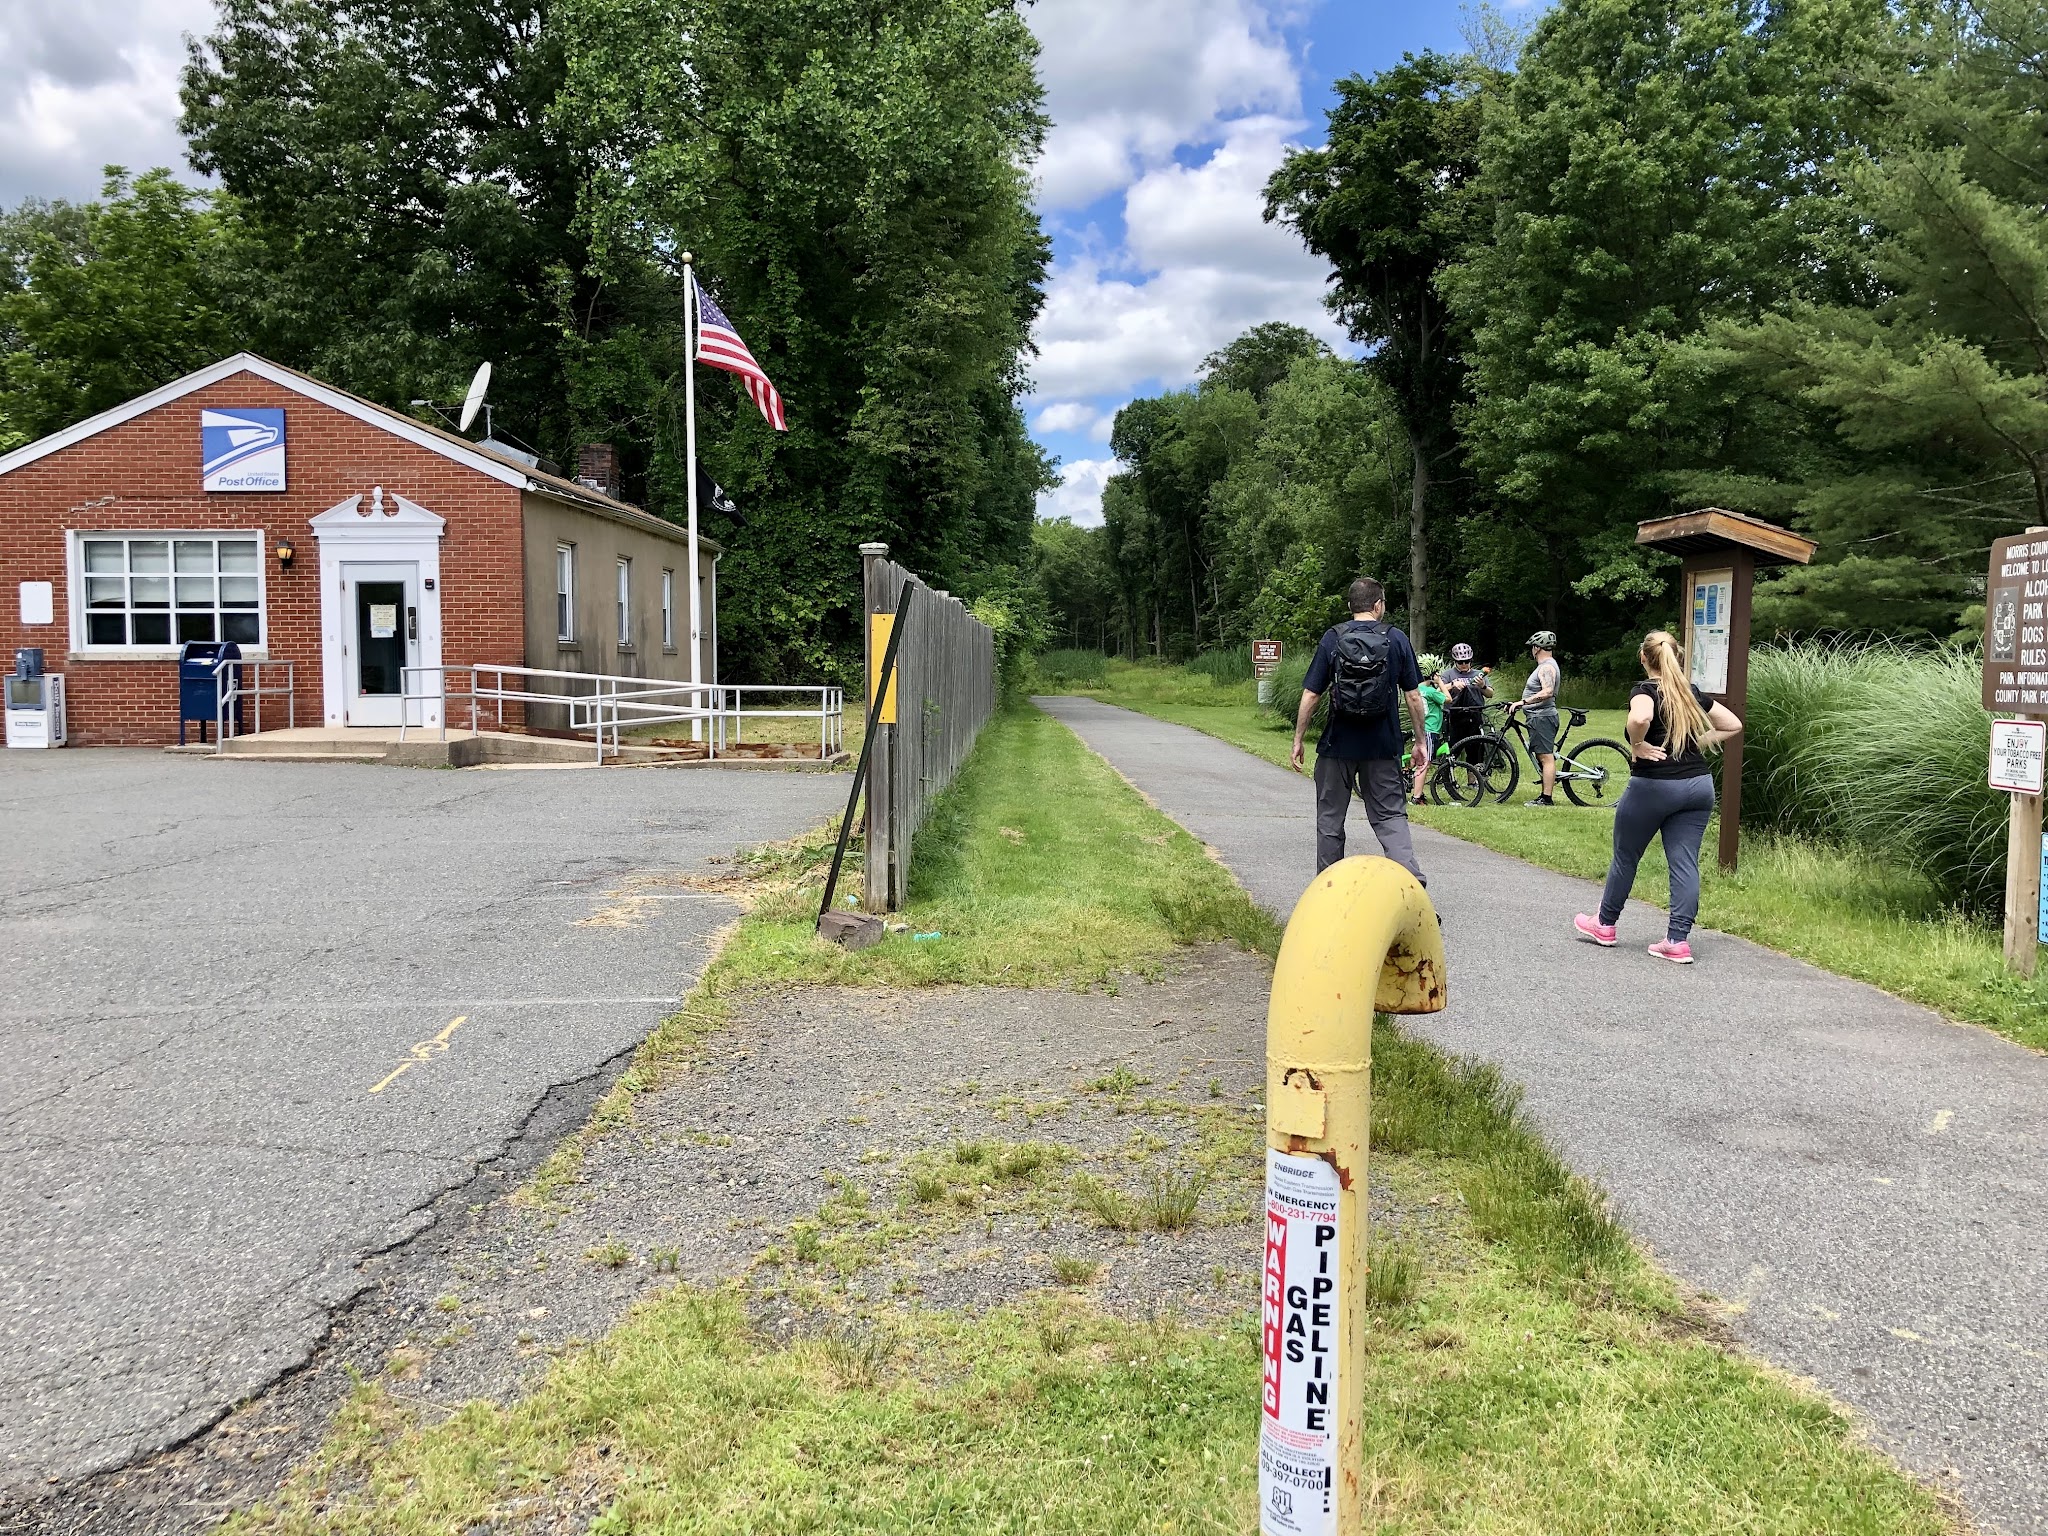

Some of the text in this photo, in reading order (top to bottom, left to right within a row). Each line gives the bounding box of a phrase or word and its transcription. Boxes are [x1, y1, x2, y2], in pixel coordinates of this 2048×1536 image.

[219, 476, 279, 486] Post Office
[2006, 543, 2029, 560] MORRIS
[2001, 561, 2030, 577] WELCOME
[2032, 560, 2040, 574] TO
[2023, 602, 2044, 620] PARK
[2022, 626, 2044, 644] DOGS
[2021, 648, 2046, 666] RULES
[2000, 671, 2015, 685] PARK
[1995, 689, 2019, 703] COUNTY
[2021, 690, 2038, 704] PARK
[2007, 738, 2029, 749] ENJOY
[1994, 748, 2042, 760] YOUR TOBACCO FREE
[2006, 758, 2027, 770] PARKS
[1274, 1162, 1315, 1178] ENBRIDGE
[1274, 1190, 1336, 1211] EMERGENCY
[1263, 1216, 1286, 1411] WARNING
[1286, 1285, 1308, 1364] GAS
[1306, 1224, 1336, 1431] PIPELINE
[1261, 1458, 1324, 1491] 09-397-0700
[1275, 1459, 1324, 1479] COLLECT
